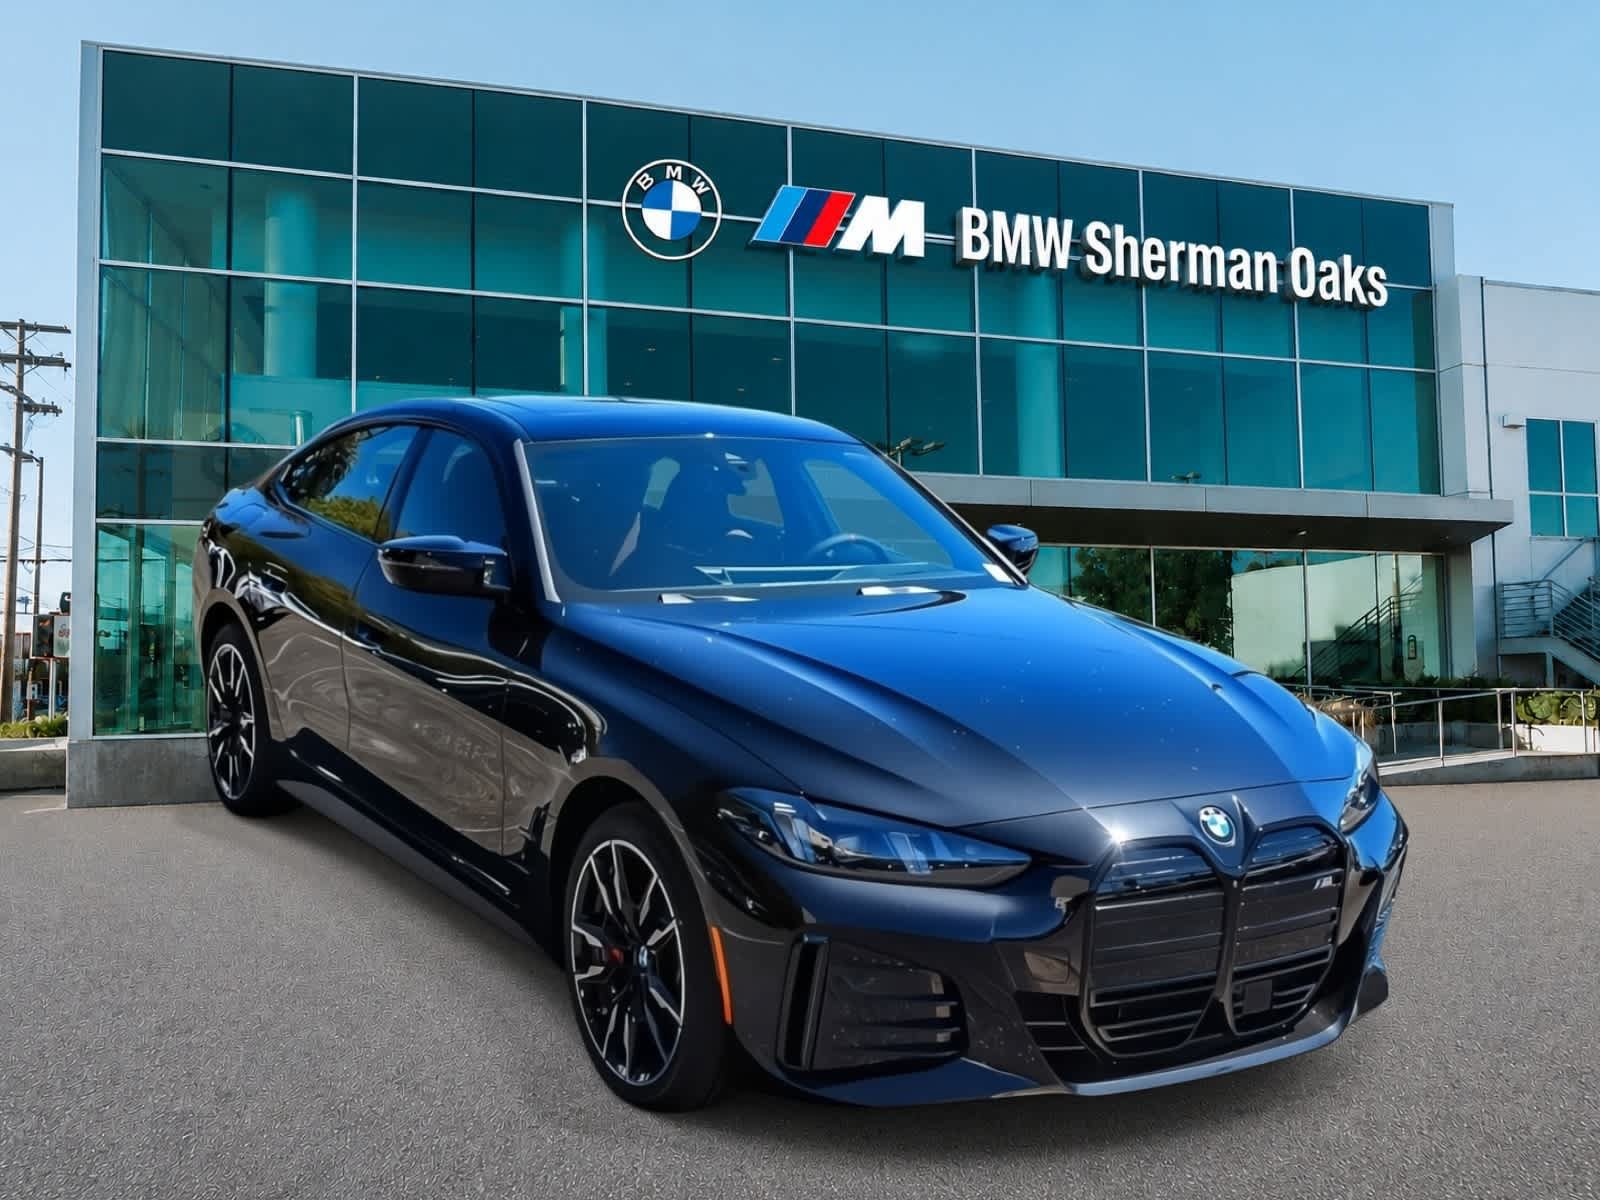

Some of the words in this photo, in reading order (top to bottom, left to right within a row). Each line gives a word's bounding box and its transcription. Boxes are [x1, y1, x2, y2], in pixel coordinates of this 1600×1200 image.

[636, 165, 711, 195] BMW
[837, 195, 925, 257] M
[960, 206, 1073, 270] BMW
[1084, 222, 1278, 293] Sherman
[1290, 247, 1388, 307] Oaks
